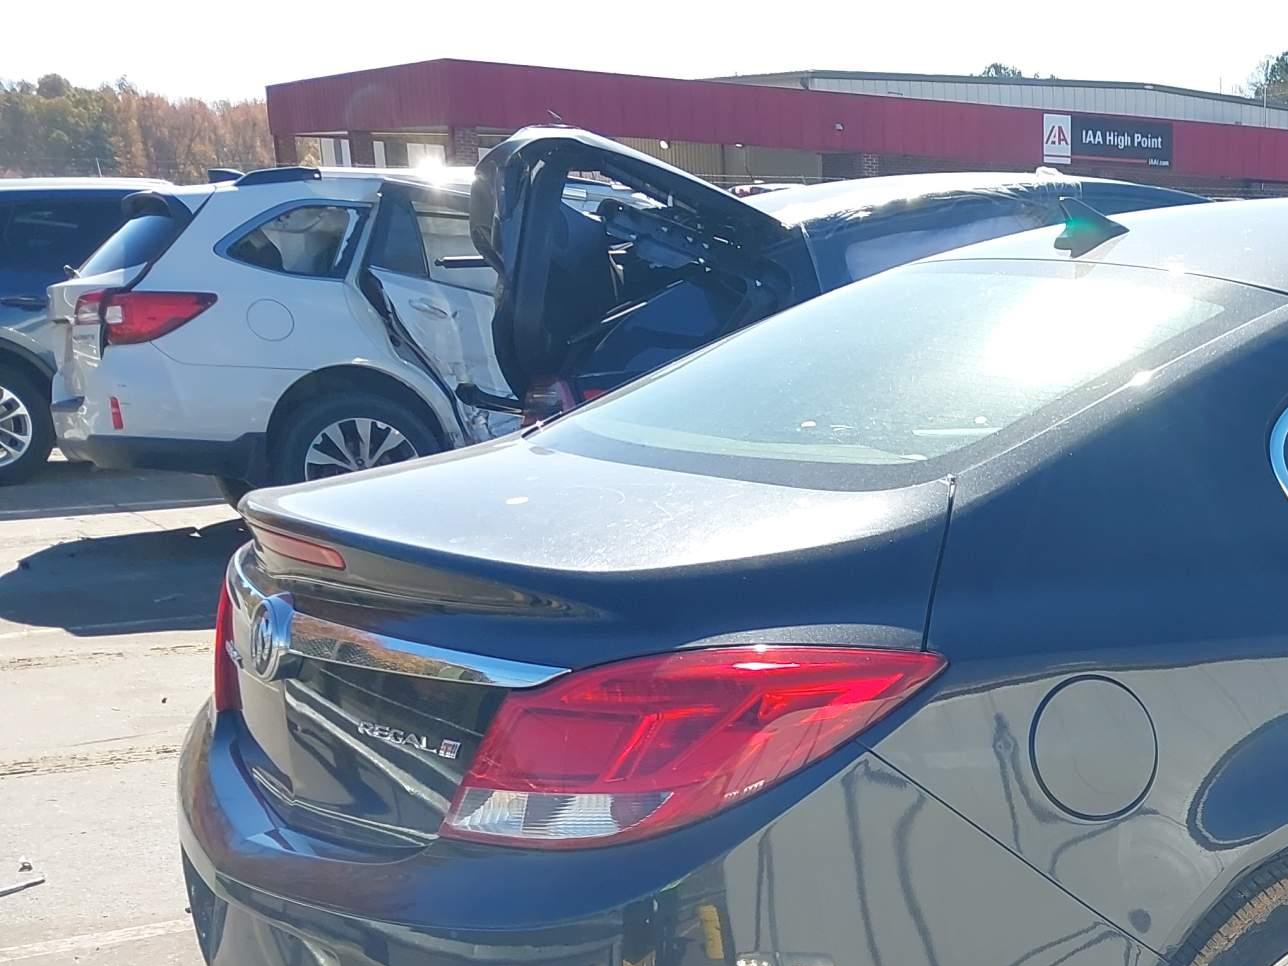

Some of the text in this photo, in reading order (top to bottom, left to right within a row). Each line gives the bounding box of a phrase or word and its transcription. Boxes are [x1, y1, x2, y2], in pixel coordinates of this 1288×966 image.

[1082, 129, 1162, 149] IAA High Point
[358, 720, 437, 755] REGAL
